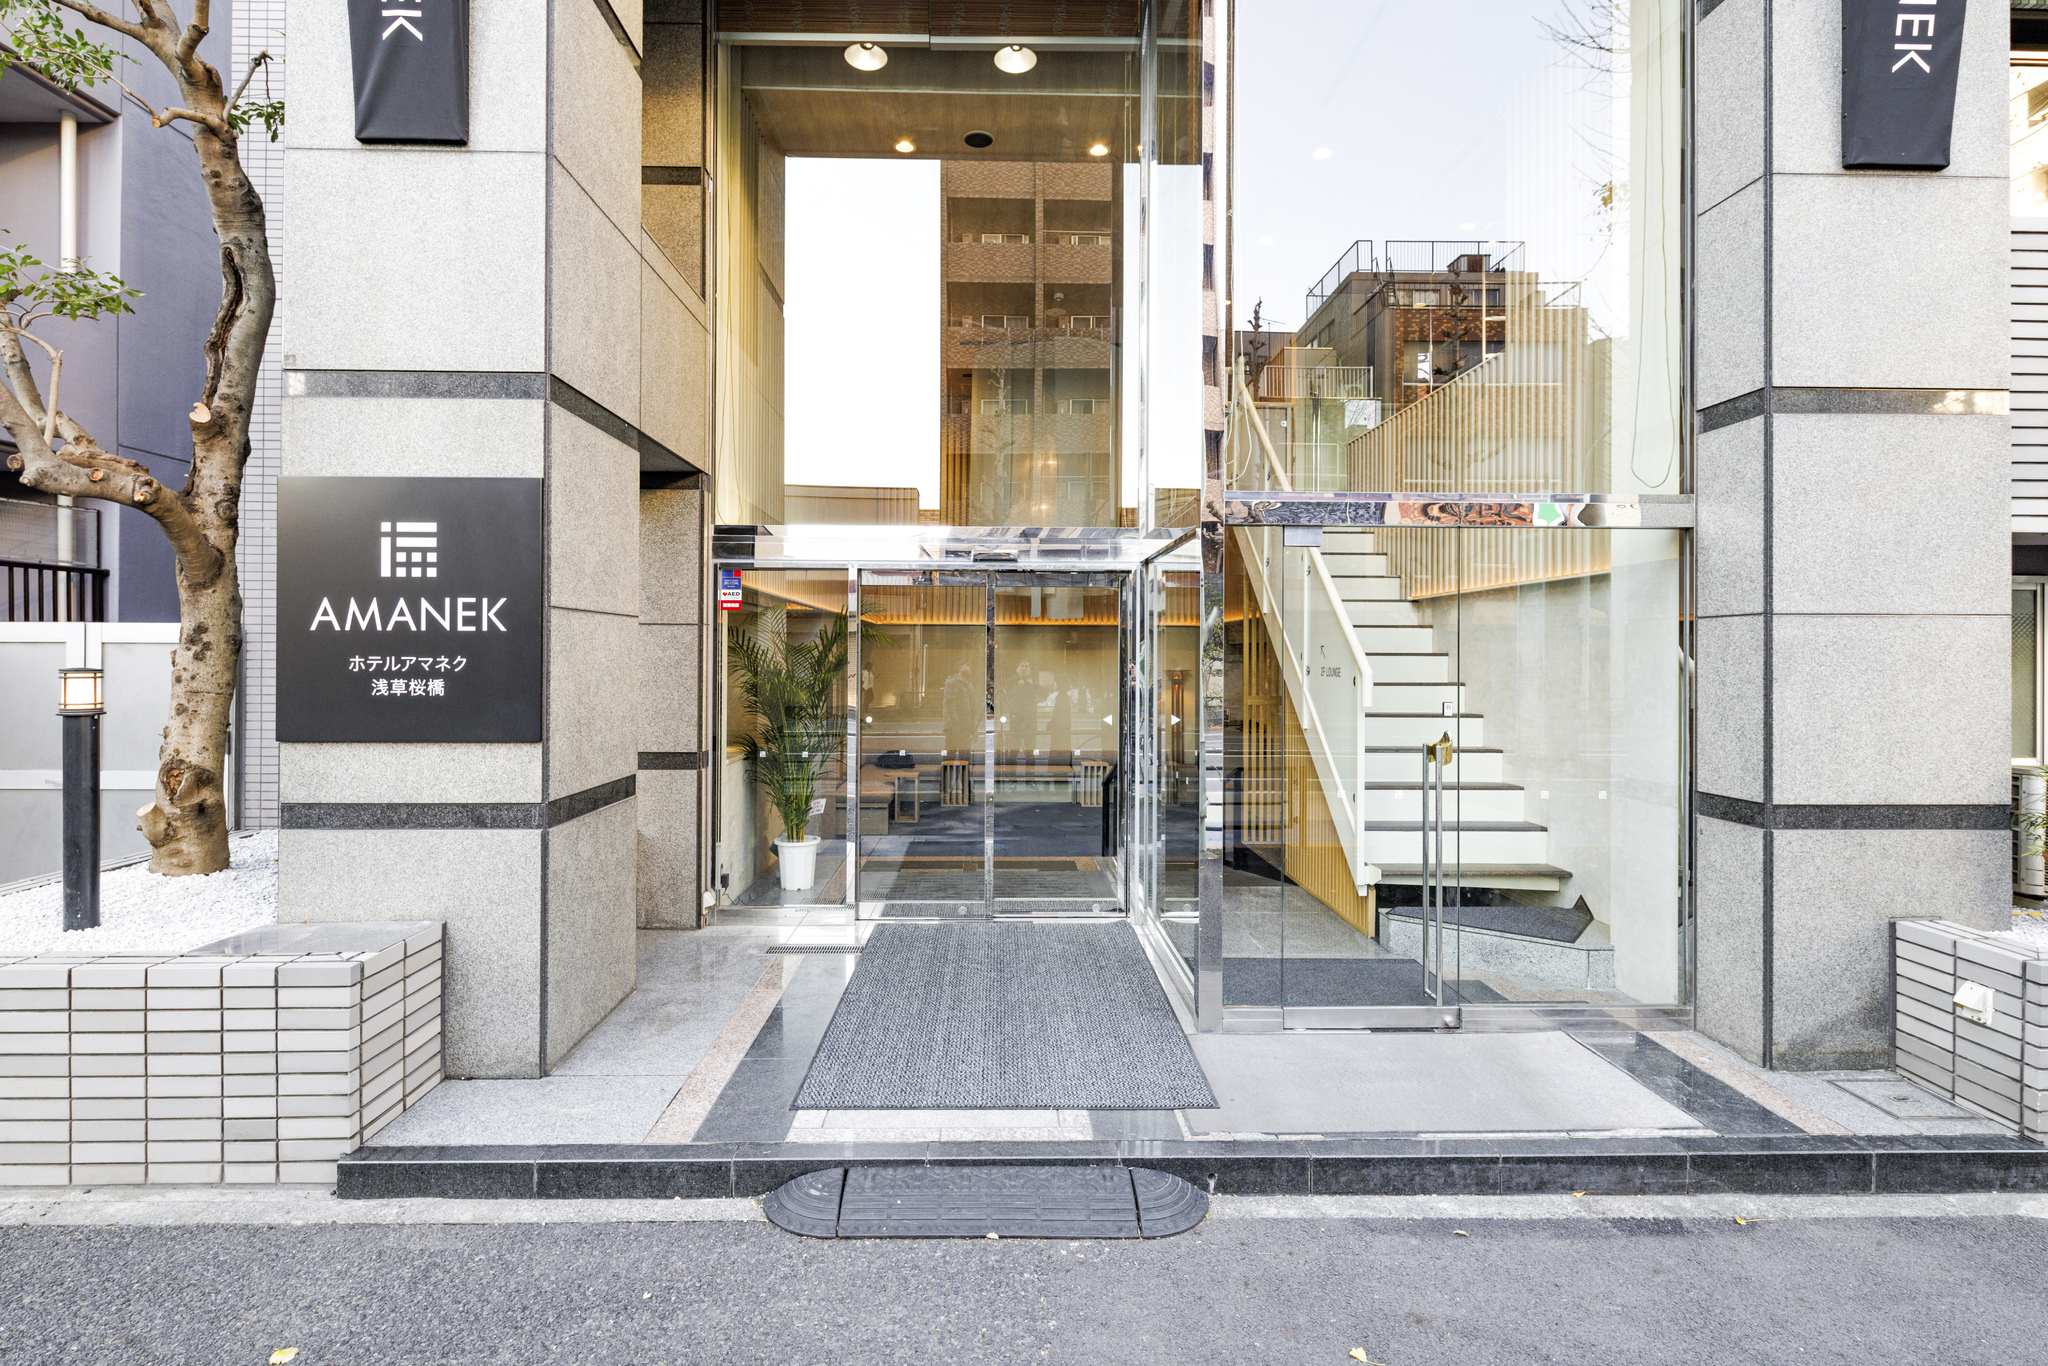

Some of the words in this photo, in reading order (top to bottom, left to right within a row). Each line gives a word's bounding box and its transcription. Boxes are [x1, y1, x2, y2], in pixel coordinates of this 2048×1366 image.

[382, 0, 423, 42] K
[1891, 0, 1938, 74] EK
[309, 596, 508, 632] AMANEK
[348, 655, 467, 672] ホテルアマネク
[1320, 667, 1326, 676] 2F
[1326, 667, 1341, 678] LOUNGE
[371, 678, 445, 697] 浅草桜橋
